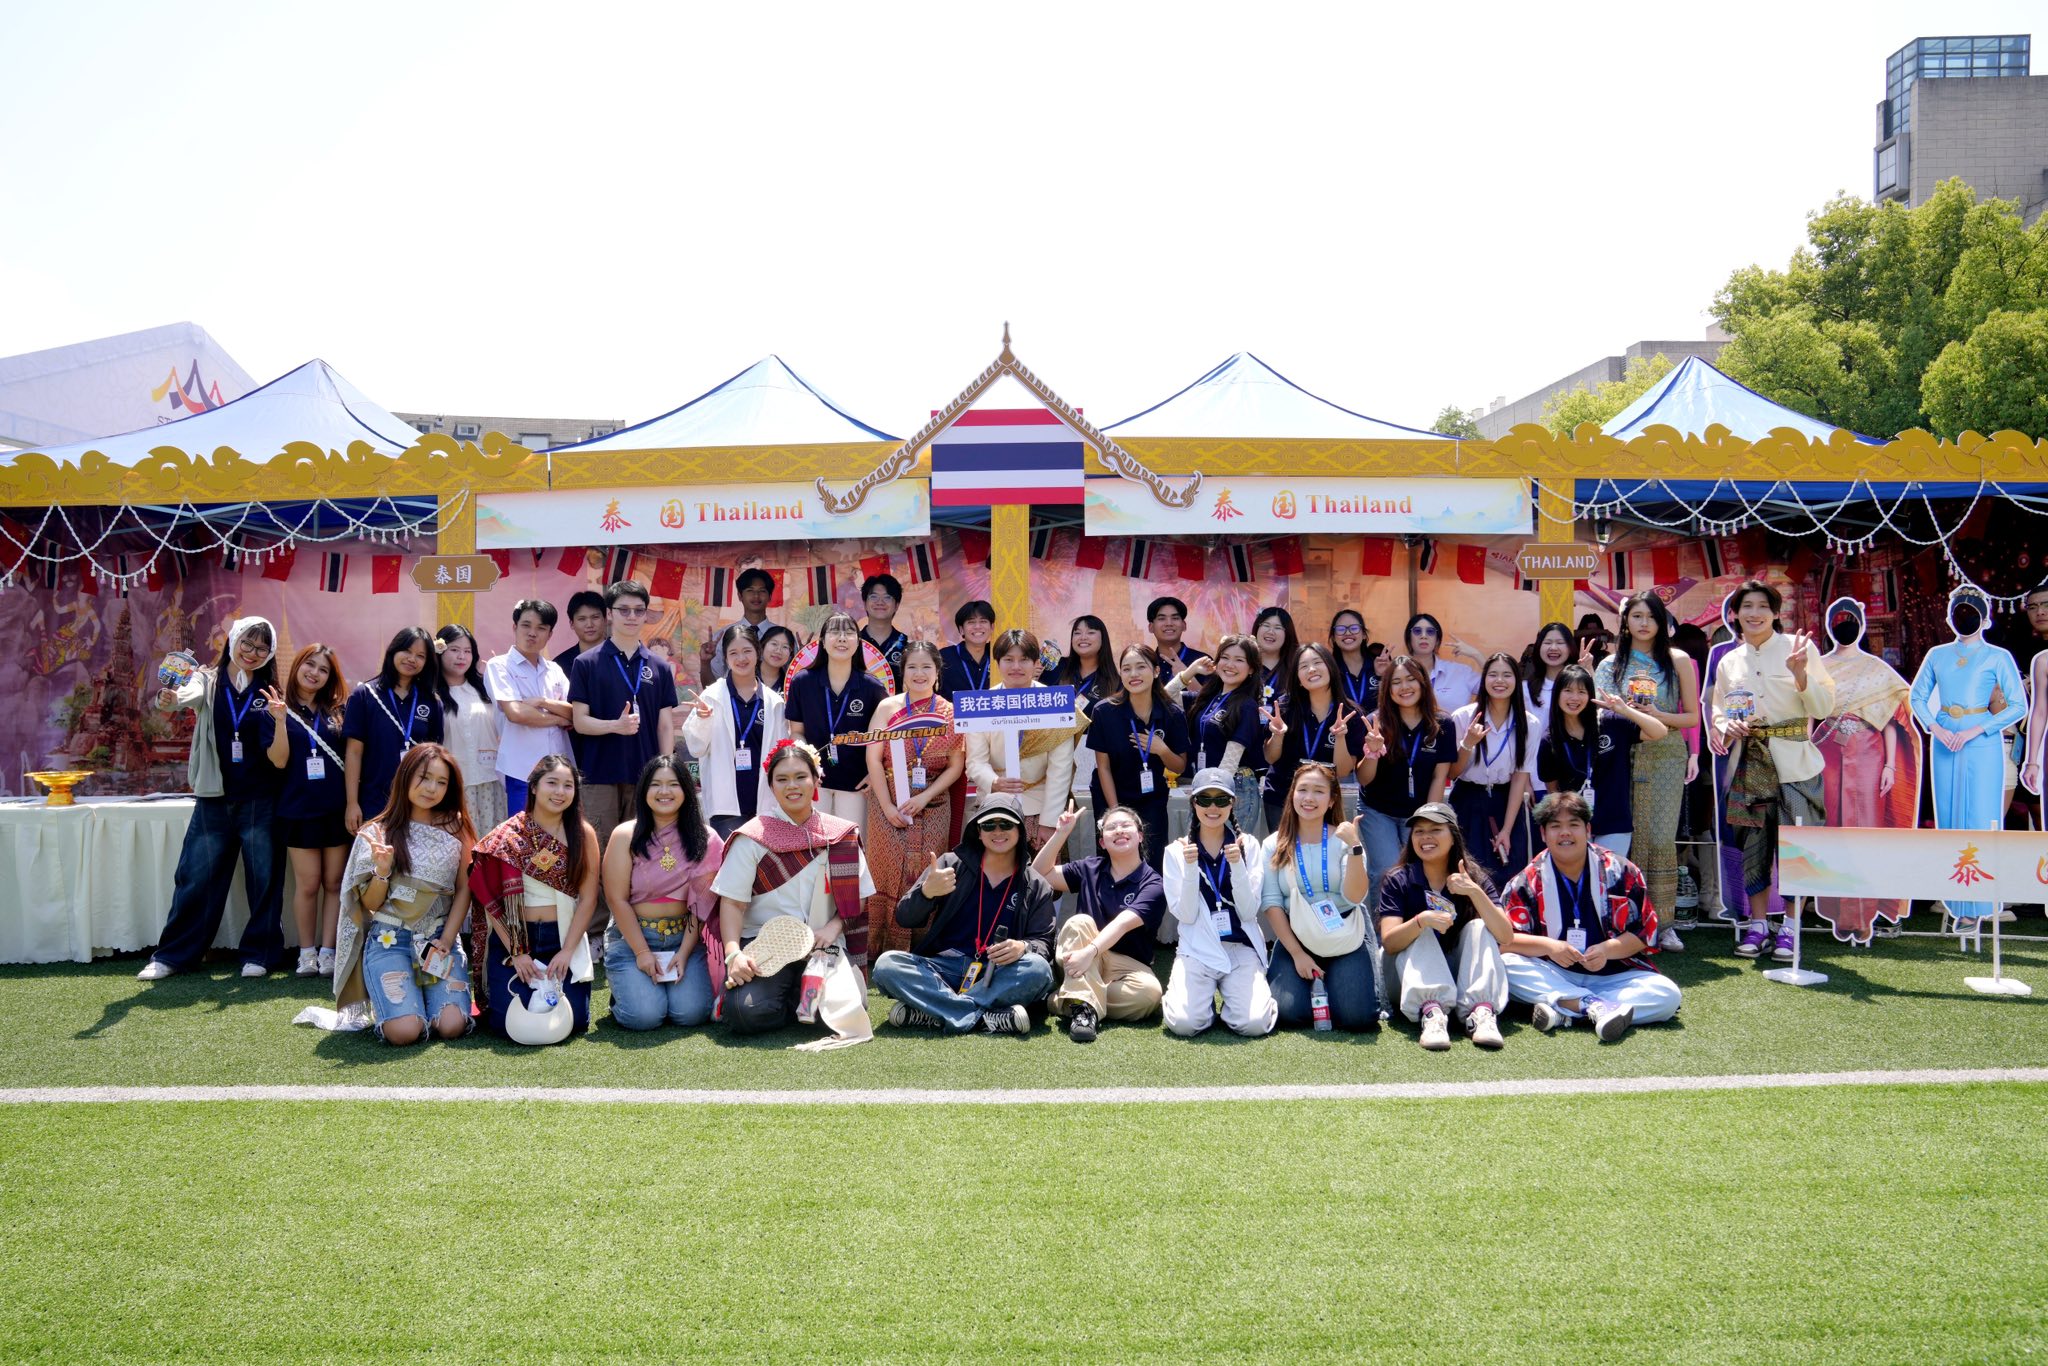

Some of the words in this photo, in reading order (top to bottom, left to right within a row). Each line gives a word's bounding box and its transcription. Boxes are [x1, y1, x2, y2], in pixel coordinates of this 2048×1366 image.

[600, 497, 684, 533] 泰国
[694, 499, 804, 522] Thailand
[1211, 487, 1296, 522] 泰国
[1305, 494, 1412, 514] Thailand
[1522, 555, 1595, 569] THAILAND
[434, 564, 472, 585] 泰国
[960, 692, 1068, 713] 我在泰国很想你
